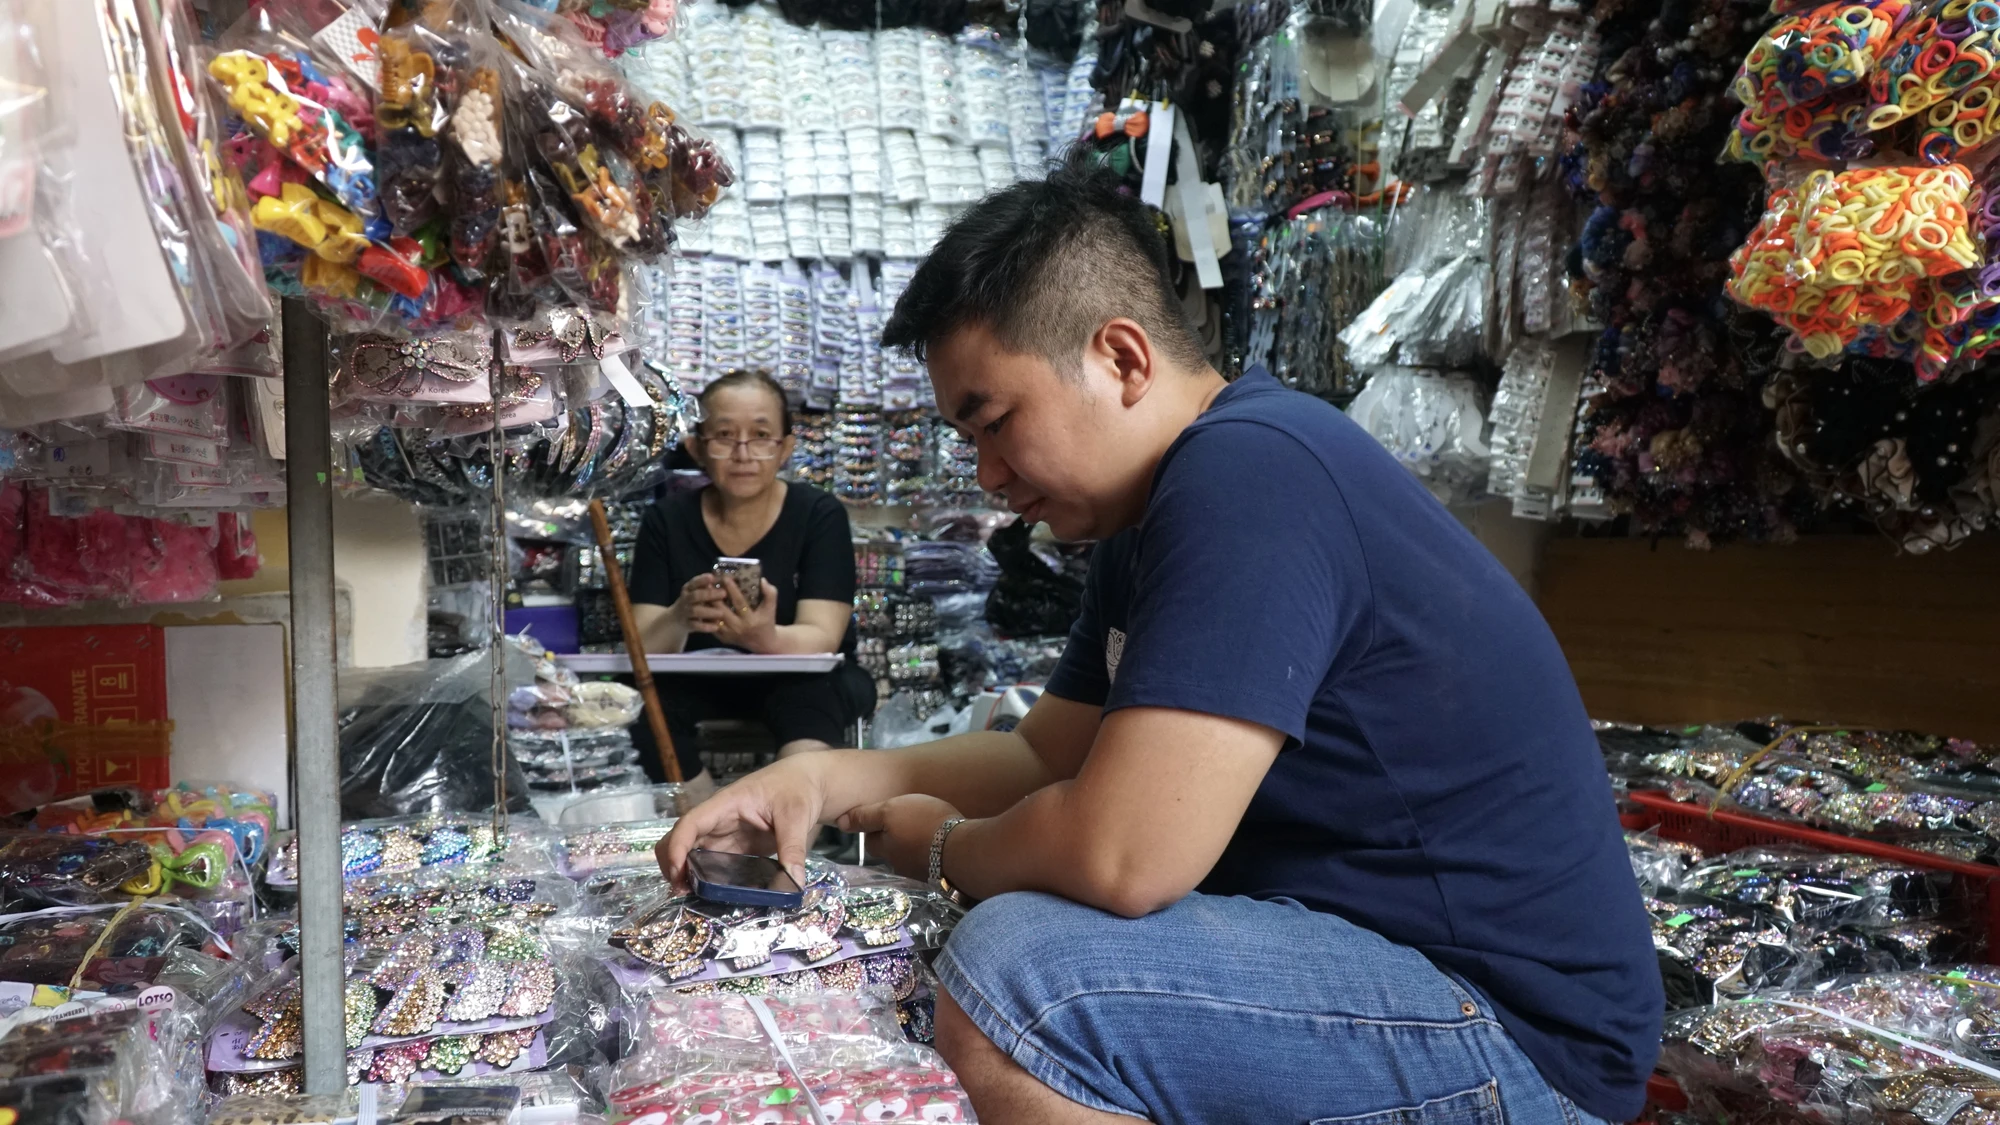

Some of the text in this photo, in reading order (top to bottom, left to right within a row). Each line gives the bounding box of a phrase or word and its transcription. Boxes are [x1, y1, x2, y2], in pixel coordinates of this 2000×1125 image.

[428, 386, 450, 394] Korea
[498, 412, 517, 420] orea
[71, 669, 91, 775] POMERANATE
[138, 992, 173, 1007] LOTSO
